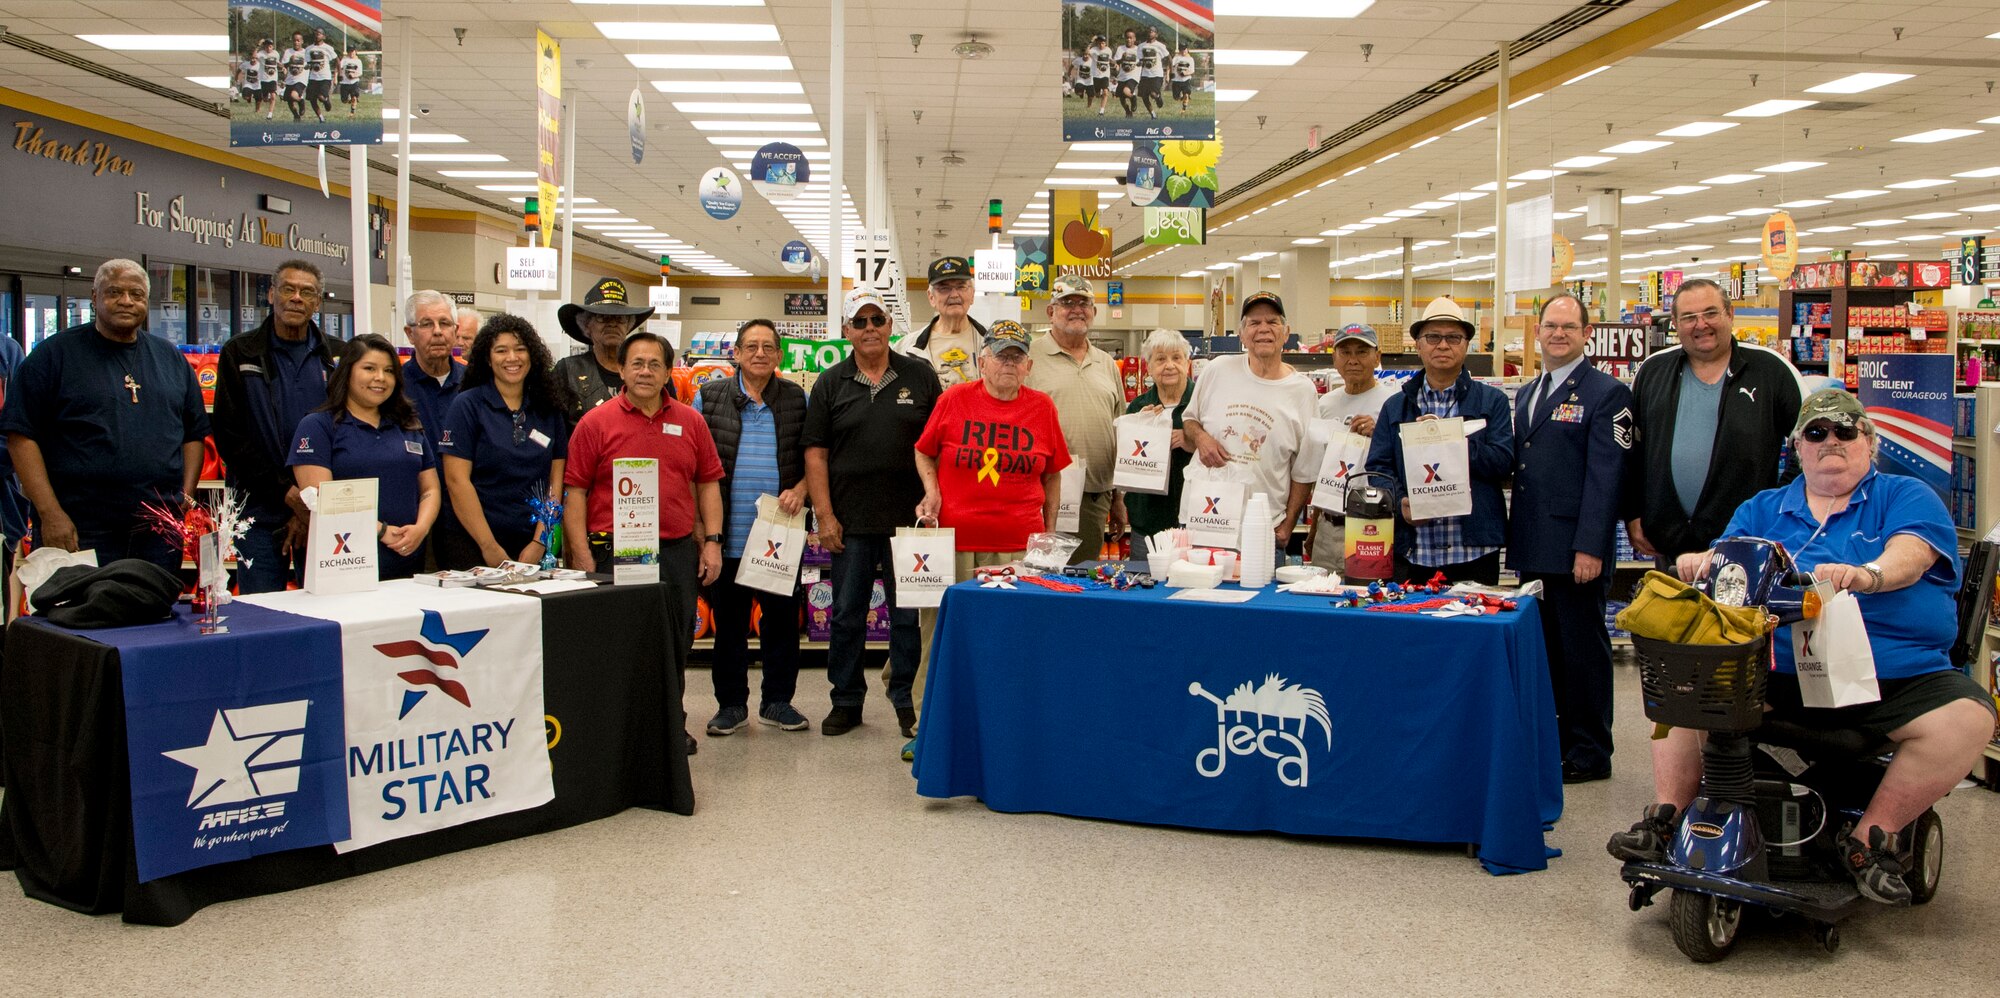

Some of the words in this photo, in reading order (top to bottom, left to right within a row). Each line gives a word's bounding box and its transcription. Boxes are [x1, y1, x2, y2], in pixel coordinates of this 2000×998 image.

[15, 121, 91, 166] Thank
[93, 143, 136, 176] You
[773, 152, 801, 160] ACCEPT
[1141, 157, 1157, 165] ACCEPT
[136, 191, 164, 228] For
[170, 195, 235, 248] Shopping
[240, 213, 255, 244] At
[259, 216, 285, 248] Your
[288, 222, 349, 266] Commissary
[520, 258, 535, 266] SELF
[987, 261, 1002, 269] SELF
[510, 270, 545, 278] CHECKOUT
[856, 258, 887, 281] 17
[1965, 256, 1975, 284] 8
[978, 272, 1013, 281] CHECKOUT
[600, 281, 625, 293] VIETNAM
[1731, 278, 1741, 300] 10
[457, 295, 473, 303] OFFICE
[788, 343, 853, 370] TO
[1858, 361, 1888, 378] EROIC
[200, 373, 215, 383] Tide
[697, 375, 710, 384] Tide
[1872, 380, 1914, 390] RESILIENT
[1891, 391, 1947, 400] COURAGEOUS
[961, 420, 1035, 452] RED
[1119, 458, 1158, 468] EXCHANGE
[618, 477, 643, 496] 0%
[1413, 484, 1457, 494] EXCHANGE
[629, 510, 635, 519] 6
[1190, 516, 1230, 526] EXCHANGE
[320, 557, 366, 568] EXCHANGE
[751, 558, 789, 572] EXCHANGE
[1798, 662, 1822, 671] EXCHANGE
[350, 718, 515, 777] MILITARY
[381, 763, 491, 820] STAR
[199, 804, 262, 831] AAFES
[193, 834, 208, 849] We
[207, 836, 222, 850] go
[222, 830, 250, 844] when
[249, 828, 268, 841] you
[270, 820, 289, 837] go!
